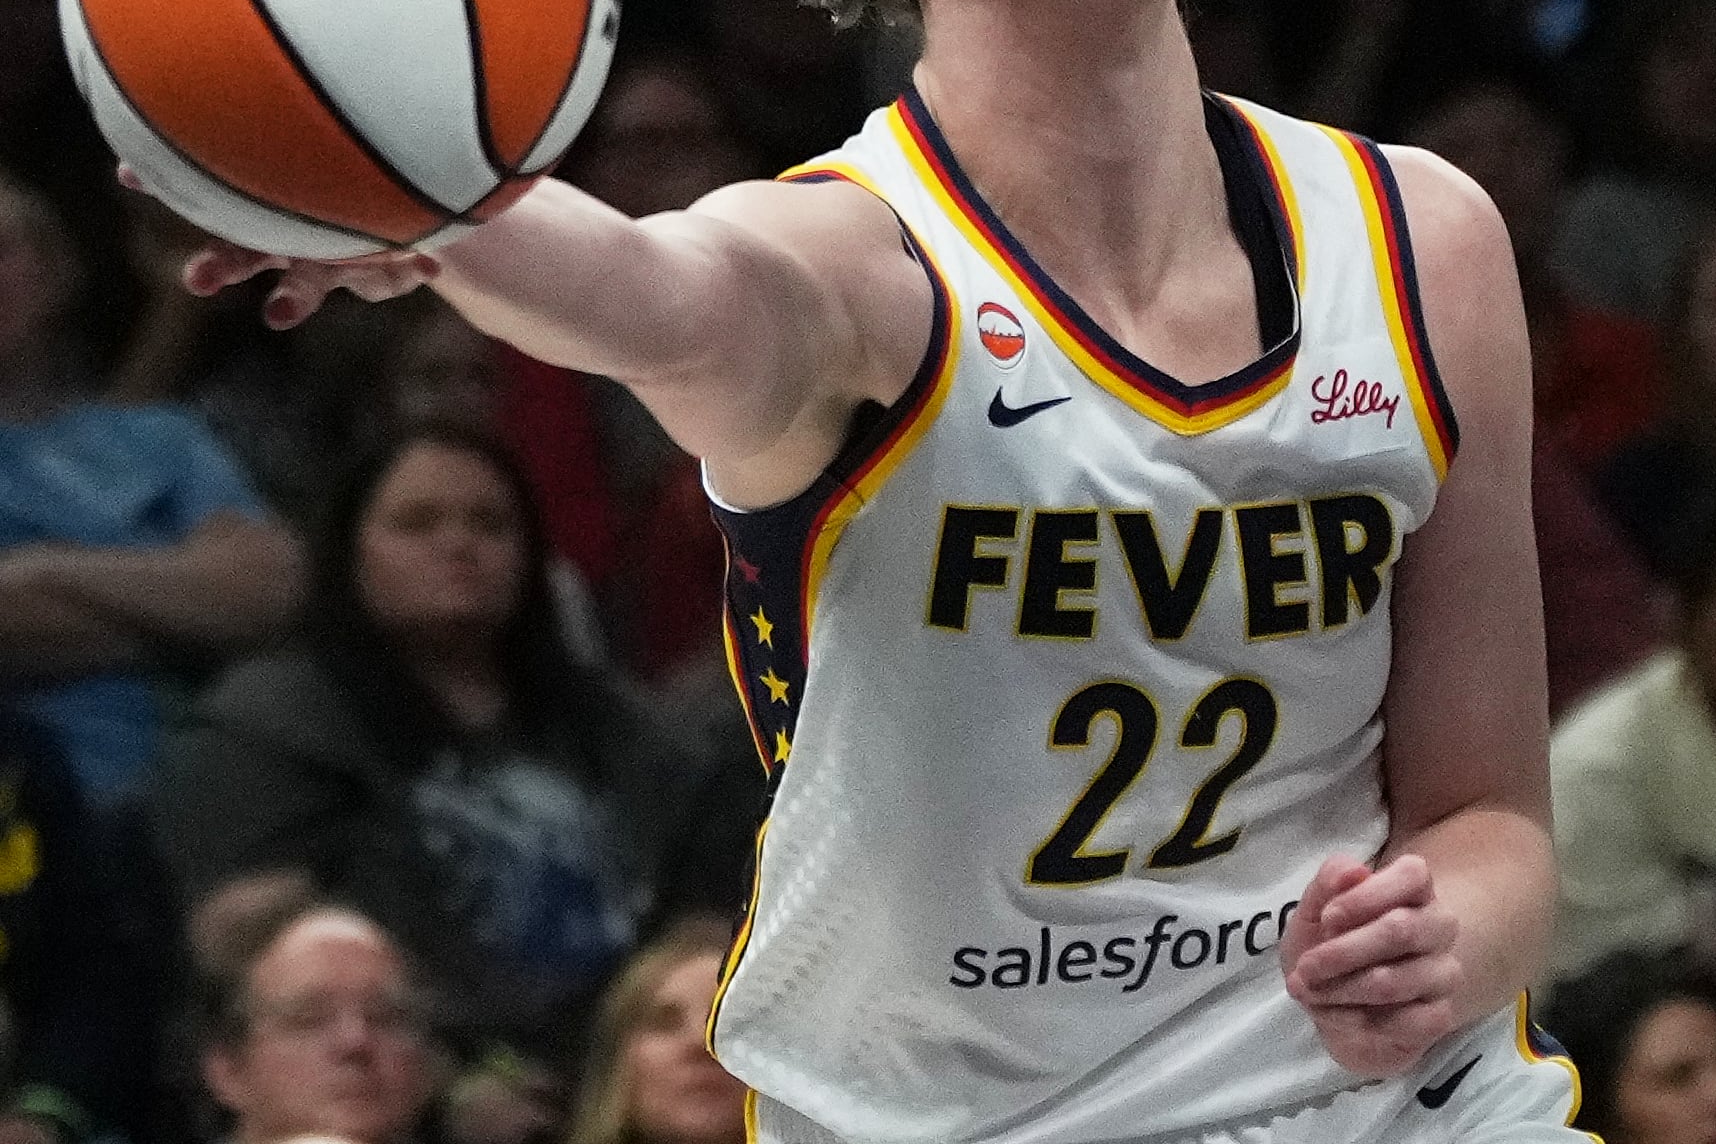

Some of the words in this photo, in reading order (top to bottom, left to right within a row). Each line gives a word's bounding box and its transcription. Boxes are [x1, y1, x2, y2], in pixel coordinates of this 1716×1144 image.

[1311, 368, 1400, 430] Lilly
[924, 492, 1402, 643] FEVER
[1024, 674, 1279, 890] 22
